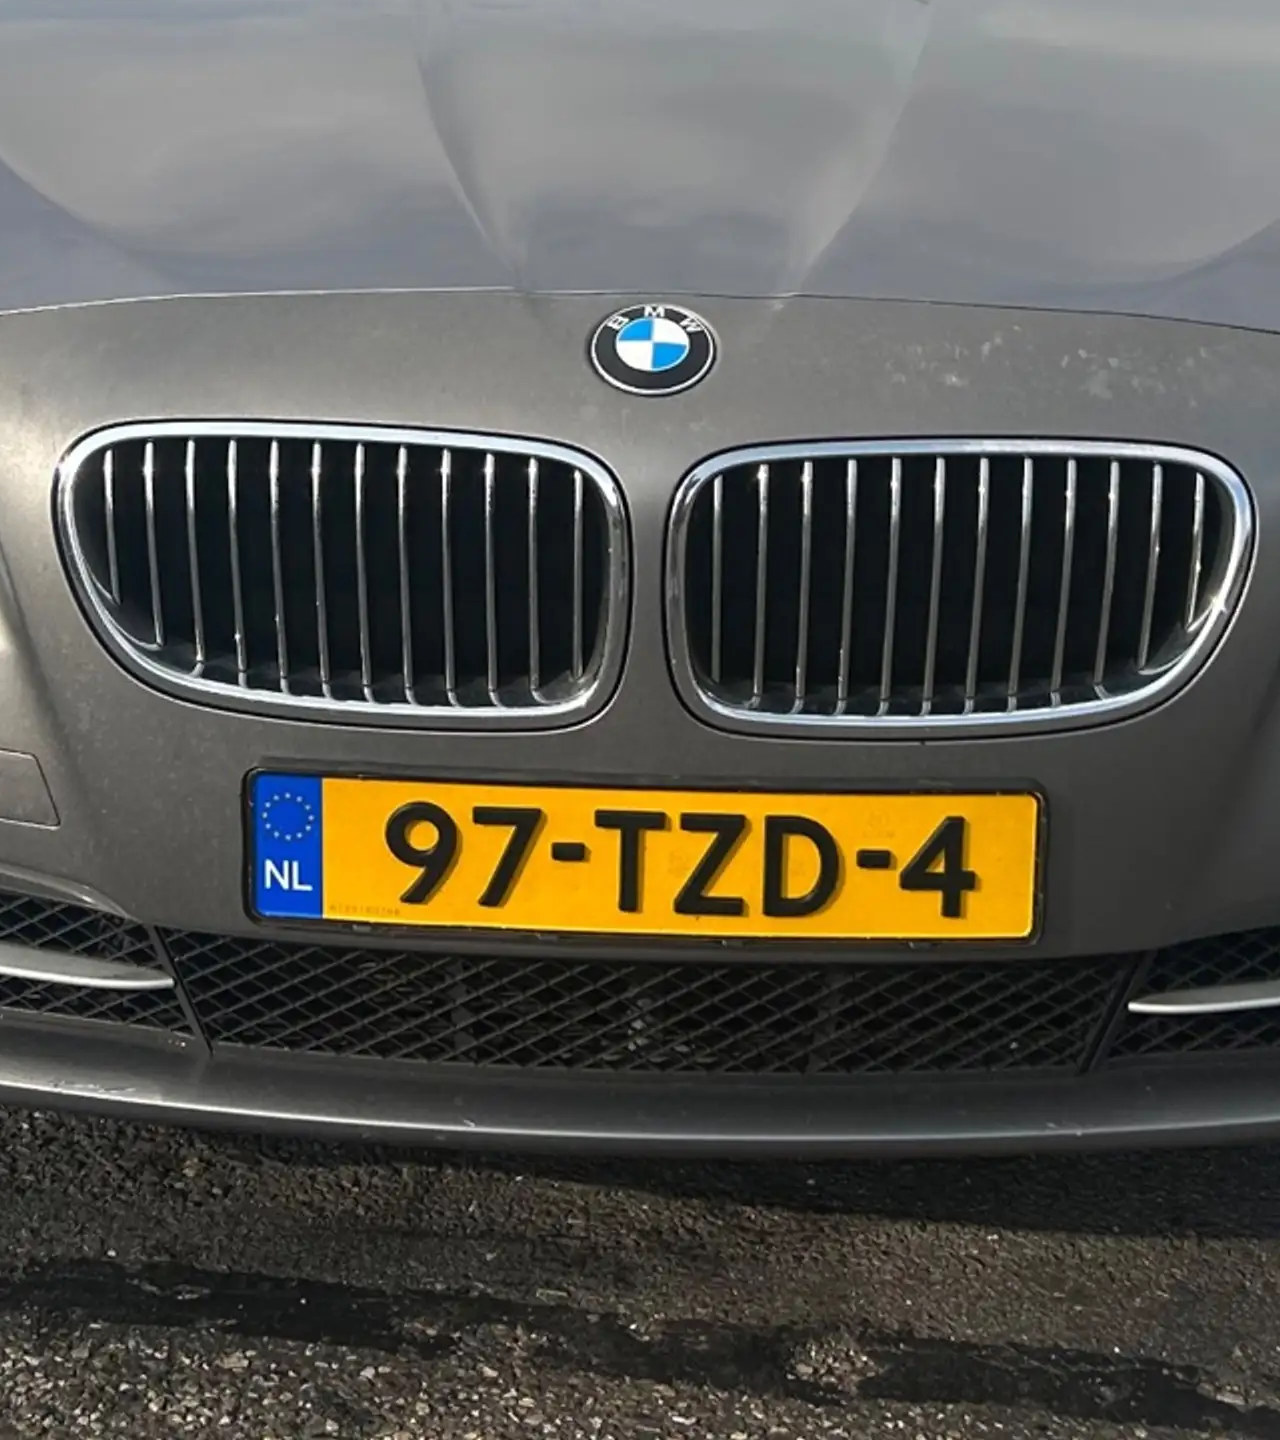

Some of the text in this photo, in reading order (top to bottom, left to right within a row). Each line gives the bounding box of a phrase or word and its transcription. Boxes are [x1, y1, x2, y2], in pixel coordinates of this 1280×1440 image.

[606, 305, 705, 333] BMW
[264, 858, 314, 892] NL
[384, 799, 979, 919] 97-TZD-4
